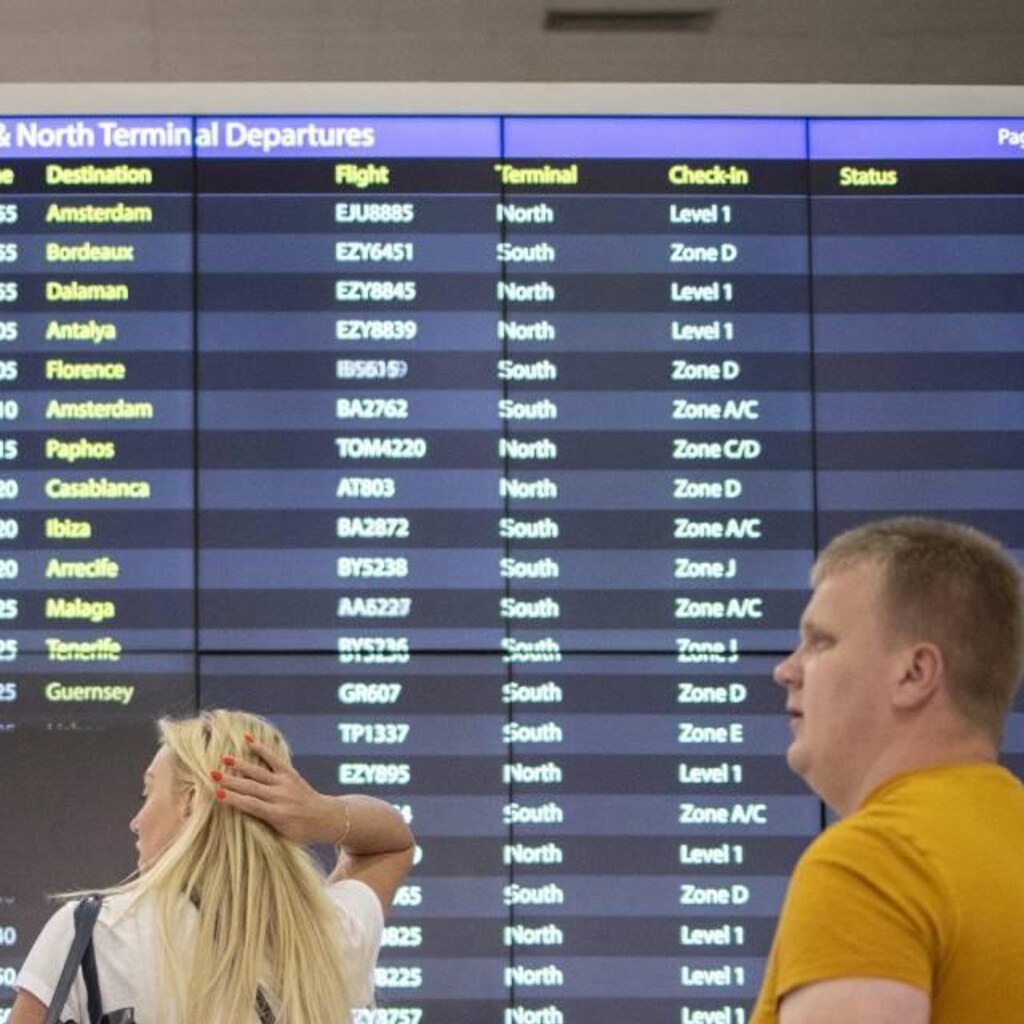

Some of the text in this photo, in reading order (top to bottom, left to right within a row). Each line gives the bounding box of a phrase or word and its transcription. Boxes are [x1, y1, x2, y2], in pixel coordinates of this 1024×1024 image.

[15, 120, 96, 149] North
[97, 121, 219, 149] Terminal
[225, 121, 376, 154] Departures
[46, 164, 153, 185] Destination
[335, 163, 390, 188] Flight
[494, 164, 578, 185] Terminal
[668, 164, 749, 185] Check-in
[839, 166, 898, 186] Status
[45, 203, 153, 223] Amsterdam
[496, 203, 554, 223] North
[669, 204, 718, 223] Level
[721, 204, 731, 223] 1
[45, 241, 135, 262] Bordeaux
[335, 241, 414, 262] EZY6451
[496, 242, 556, 262] South
[669, 242, 719, 263] Zone
[720, 242, 738, 263] D
[46, 281, 129, 301] Dalaman
[497, 281, 555, 302] North
[671, 282, 720, 302] Level
[722, 282, 733, 302] 1
[45, 319, 117, 344] Antalya
[497, 320, 556, 341] North
[671, 321, 721, 341] Level
[723, 321, 734, 341] 1
[46, 359, 126, 380] Florence
[497, 359, 557, 380] South
[671, 360, 721, 380] Zone
[722, 360, 740, 380] D
[45, 398, 154, 419] Amsterdam
[336, 398, 409, 419] BA2762
[497, 398, 558, 420] South
[672, 399, 722, 420] Zone
[722, 399, 759, 420] A/C
[45, 438, 115, 462] Paphos
[335, 437, 427, 459] TOM4220
[498, 438, 557, 459] North
[672, 438, 723, 459] Zone
[722, 438, 761, 459] C/D
[44, 477, 151, 499] Casablanca
[335, 477, 396, 498] AT803
[498, 477, 558, 499] North
[673, 478, 723, 499] Zone
[724, 478, 742, 499] D
[45, 518, 92, 539] Ibiza
[336, 517, 410, 538] BA2872
[499, 517, 559, 539] South
[673, 518, 724, 538] Zone
[724, 518, 761, 538] A/C
[45, 556, 120, 579] Arrecife
[498, 557, 560, 579] South
[673, 557, 725, 579] Zone
[724, 557, 737, 579] J
[45, 597, 116, 623] Malaga
[499, 597, 560, 619] South
[674, 597, 725, 619] Zone
[725, 597, 763, 619] A/C
[44, 636, 122, 662] Tenerife
[500, 637, 562, 663] South
[675, 637, 727, 664] Zone
[727, 637, 739, 664] J
[45, 682, 134, 704] Guernsey
[338, 682, 402, 704] GR607
[502, 681, 563, 703] South
[677, 682, 728, 703] Zone
[728, 682, 747, 703] D
[337, 721, 744, 744] TP1337 South Zone E
[502, 762, 563, 783] North
[678, 763, 729, 784] Level
[731, 763, 742, 784] 1
[502, 802, 767, 825] South Zone A/C
[503, 842, 743, 864] North Level 1
[502, 883, 750, 906] South Zone D
[503, 923, 564, 946] North
[680, 924, 731, 945] Level
[733, 924, 744, 945] 1
[503, 964, 564, 987] North
[680, 965, 732, 987] Level
[733, 965, 745, 987] 1
